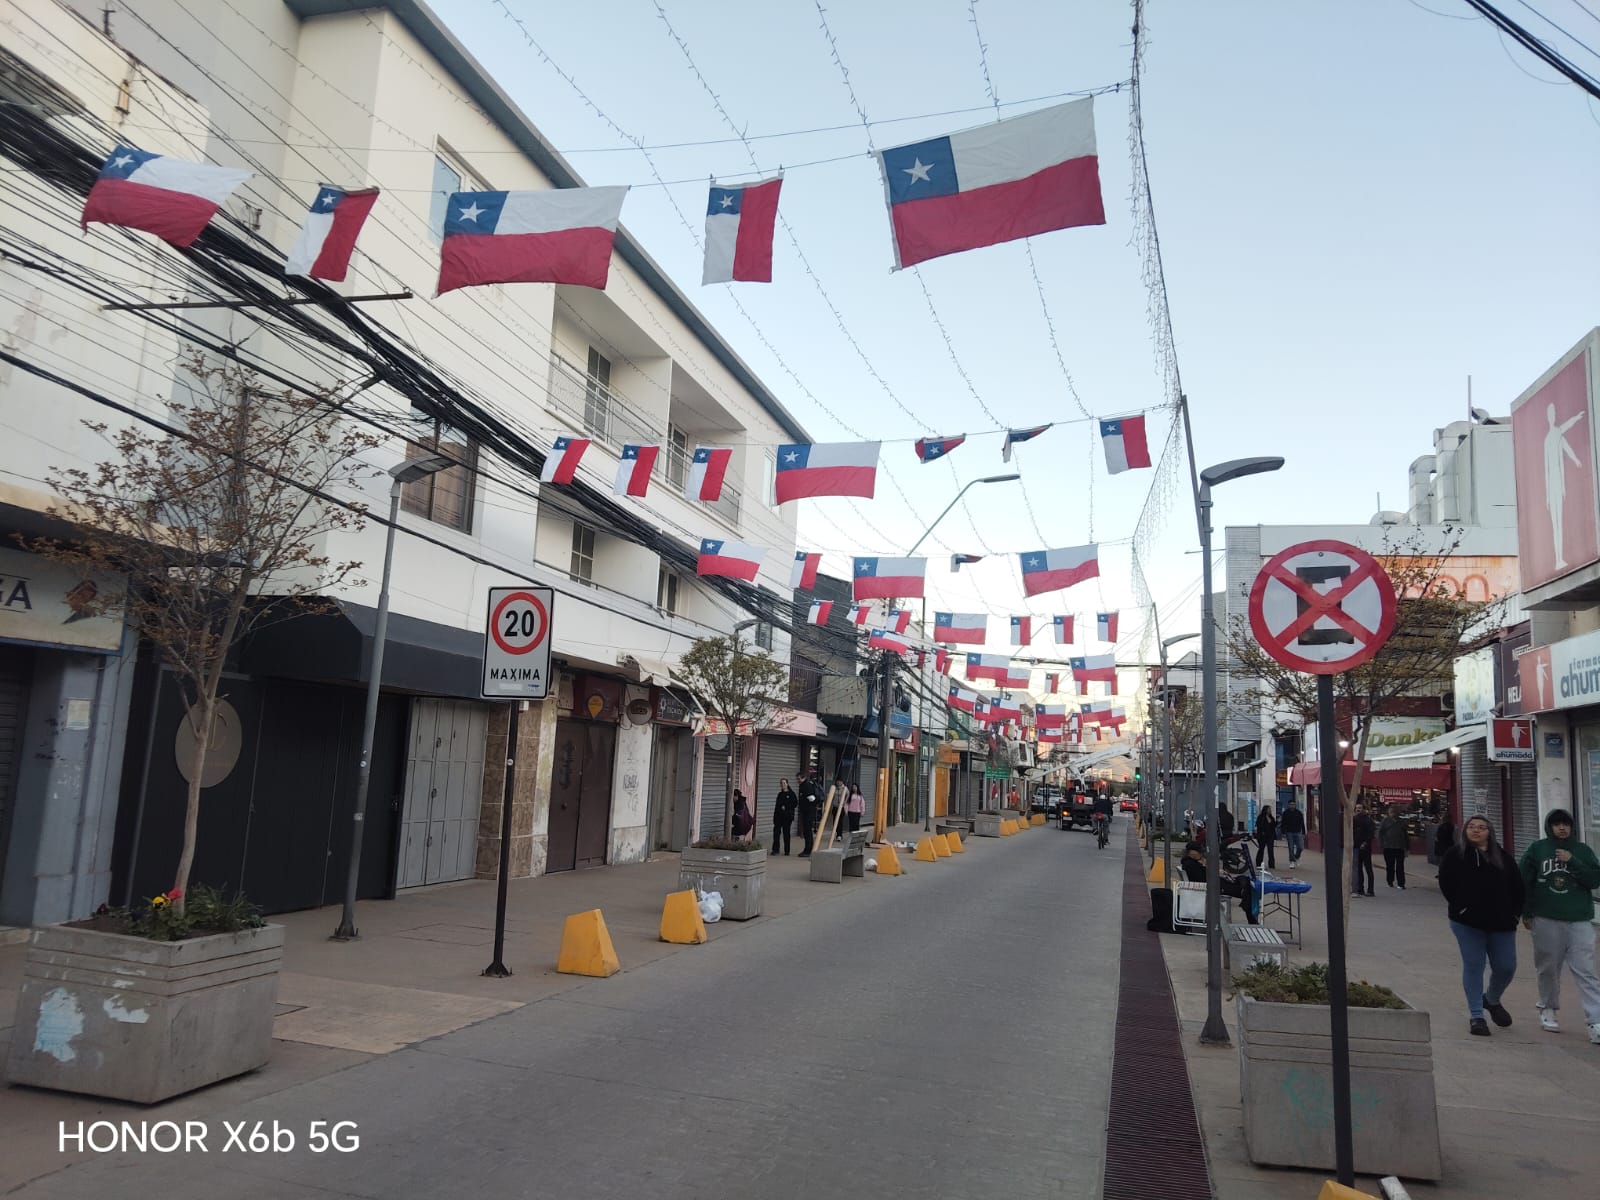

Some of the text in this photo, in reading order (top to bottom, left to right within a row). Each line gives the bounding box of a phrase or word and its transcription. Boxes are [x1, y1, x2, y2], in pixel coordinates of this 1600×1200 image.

[0, 579, 32, 610] A
[504, 610, 534, 637] 20
[490, 668, 540, 680] MAXIMA
[1508, 686, 1522, 704] HEL
